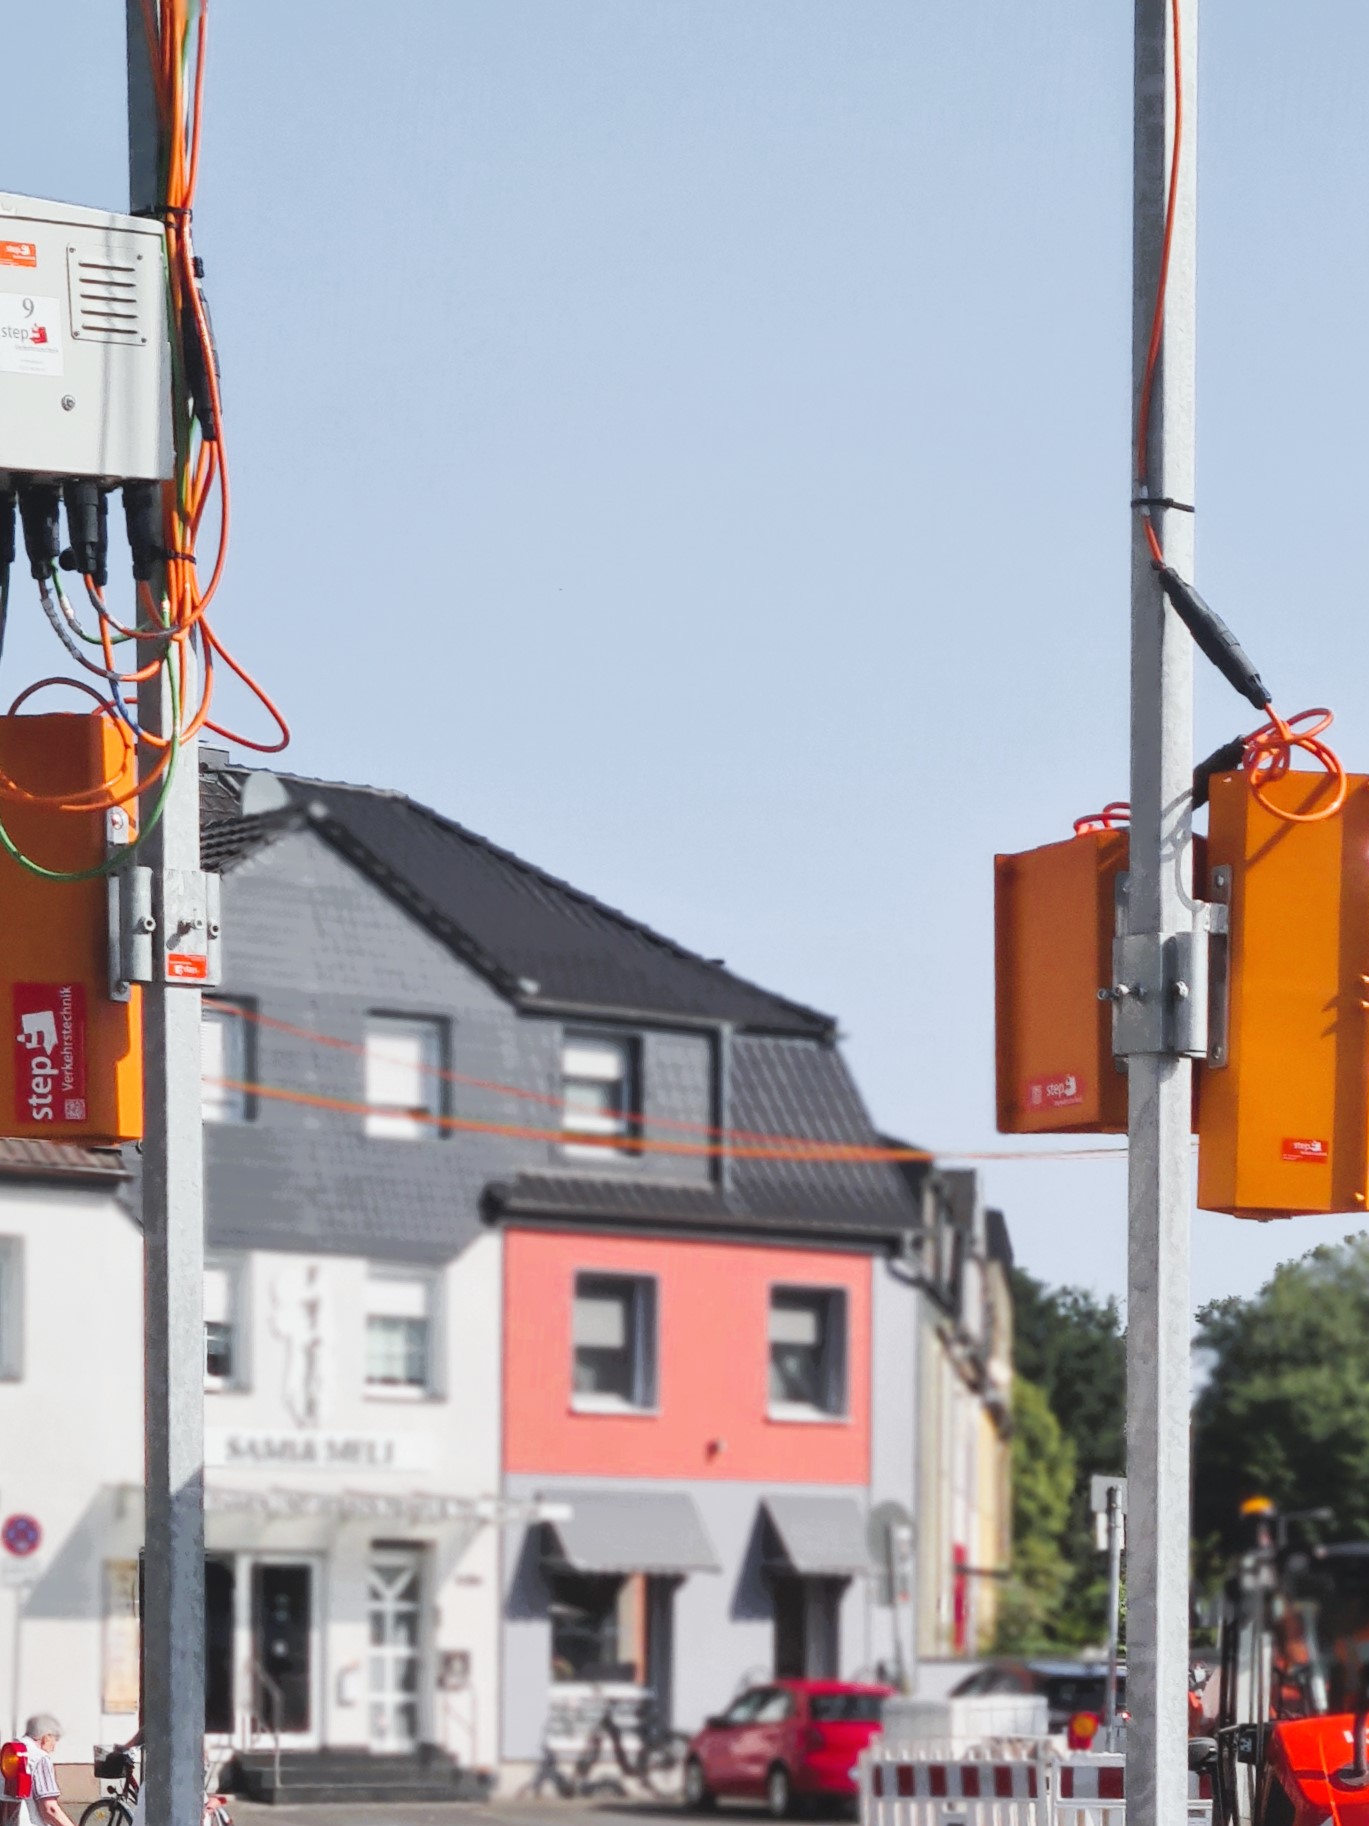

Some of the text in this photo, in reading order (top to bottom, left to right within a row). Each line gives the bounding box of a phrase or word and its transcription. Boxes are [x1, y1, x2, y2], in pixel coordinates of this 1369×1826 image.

[22, 297, 35, 319] 9
[1, 325, 29, 343] step
[59, 985, 74, 1092] Verkehrstechnik
[28, 1055, 59, 1121] step
